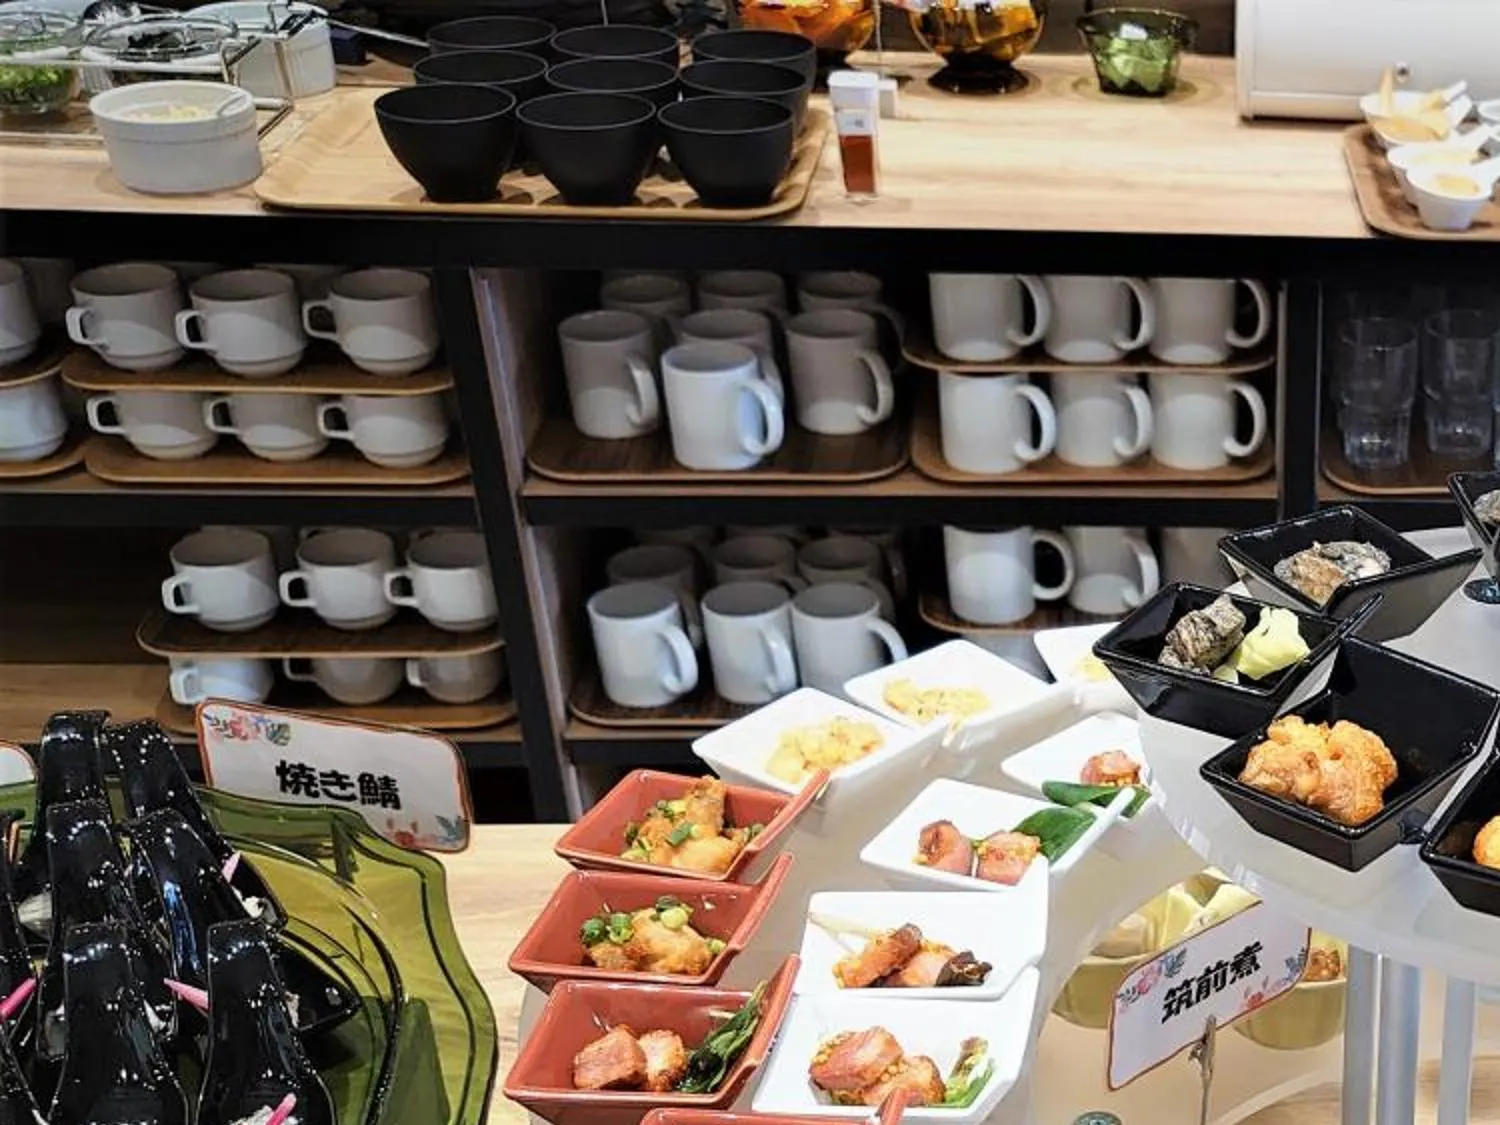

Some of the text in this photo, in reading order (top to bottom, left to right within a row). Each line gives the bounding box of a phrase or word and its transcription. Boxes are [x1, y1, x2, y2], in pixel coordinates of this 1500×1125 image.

[275, 760, 401, 810] 焼き鯖
[1161, 940, 1263, 1024] 筑前煮
